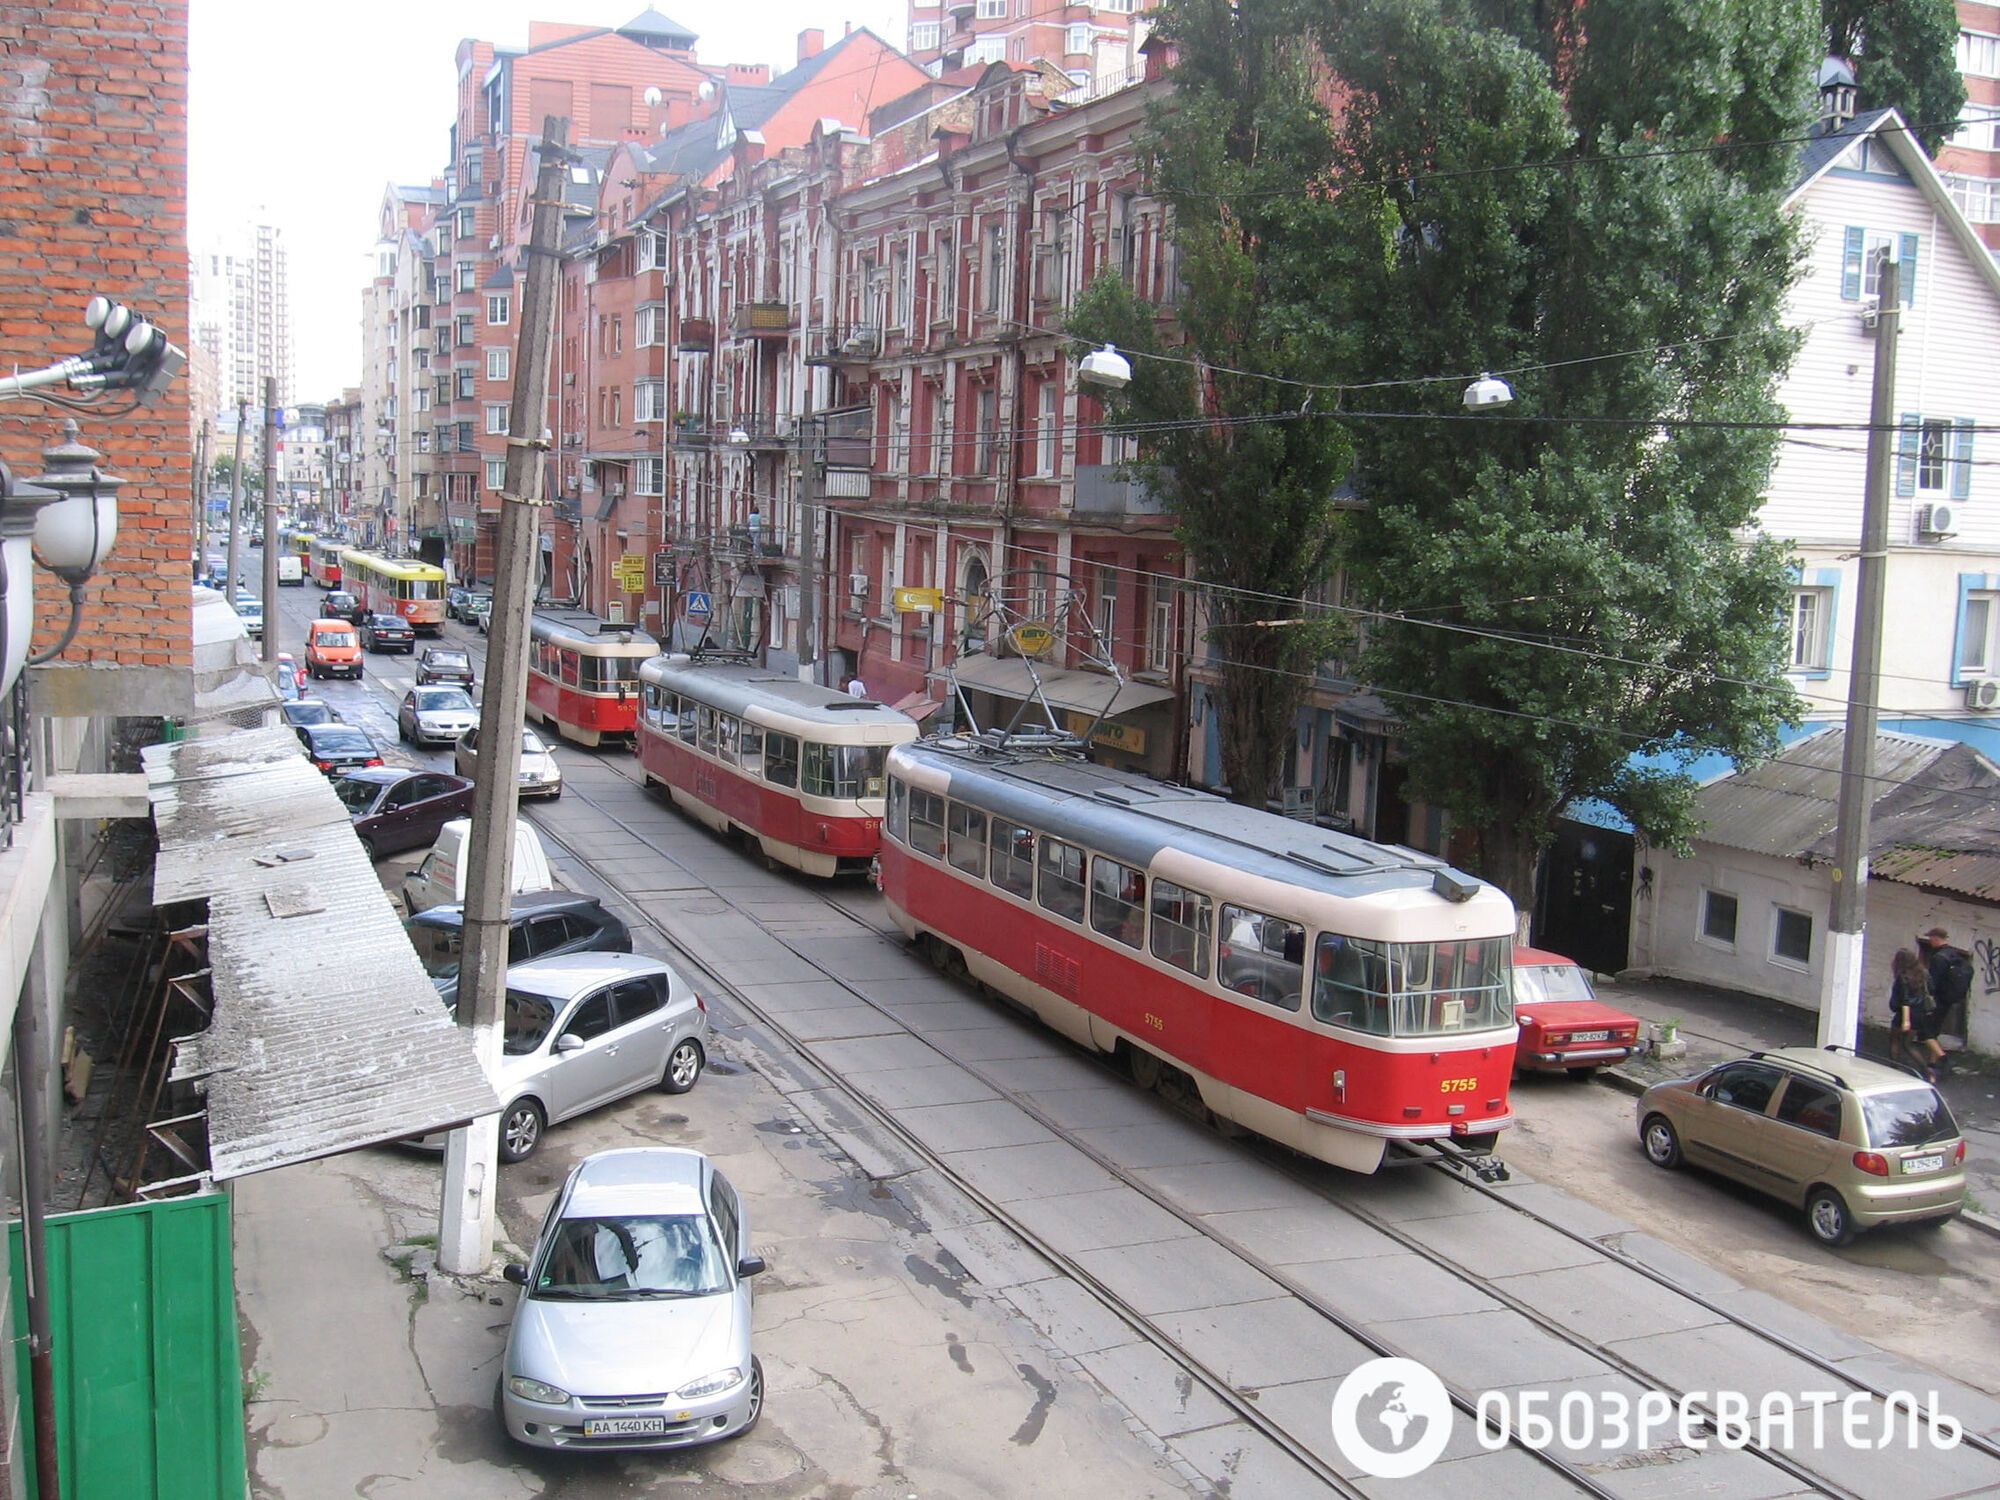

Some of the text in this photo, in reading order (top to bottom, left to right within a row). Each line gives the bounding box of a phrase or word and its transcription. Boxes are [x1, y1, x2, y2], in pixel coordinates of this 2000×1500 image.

[1144, 1012, 1164, 1031] 5755
[1440, 1078, 1477, 1093] 5755
[593, 1420, 662, 1433] AA 1440 KH
